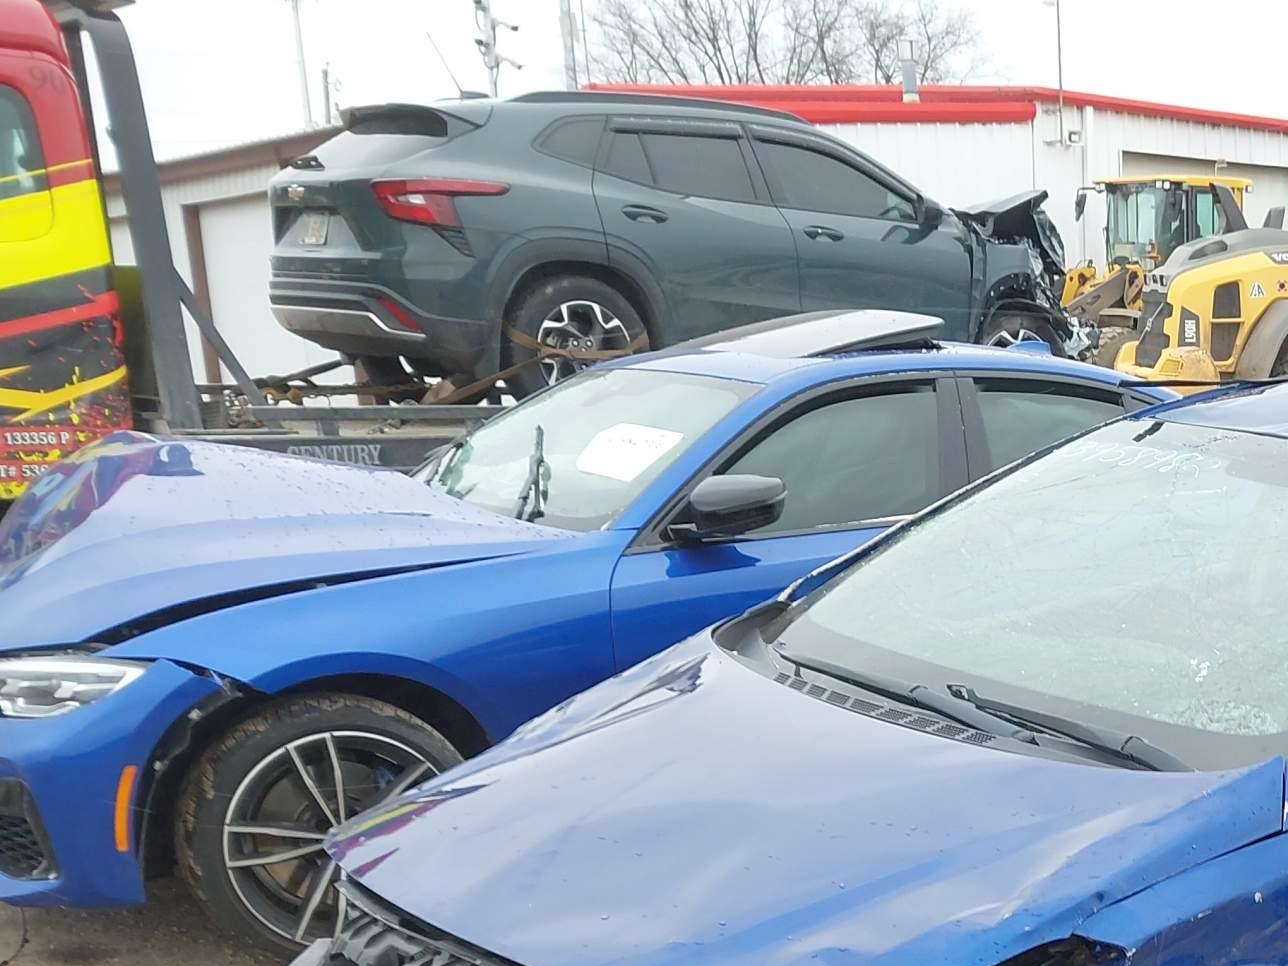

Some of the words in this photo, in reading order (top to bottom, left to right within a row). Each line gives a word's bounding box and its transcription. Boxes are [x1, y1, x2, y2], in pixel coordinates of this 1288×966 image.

[1184, 319, 1197, 343] L90H
[4, 431, 57, 445] 133356
[60, 431, 70, 445] P
